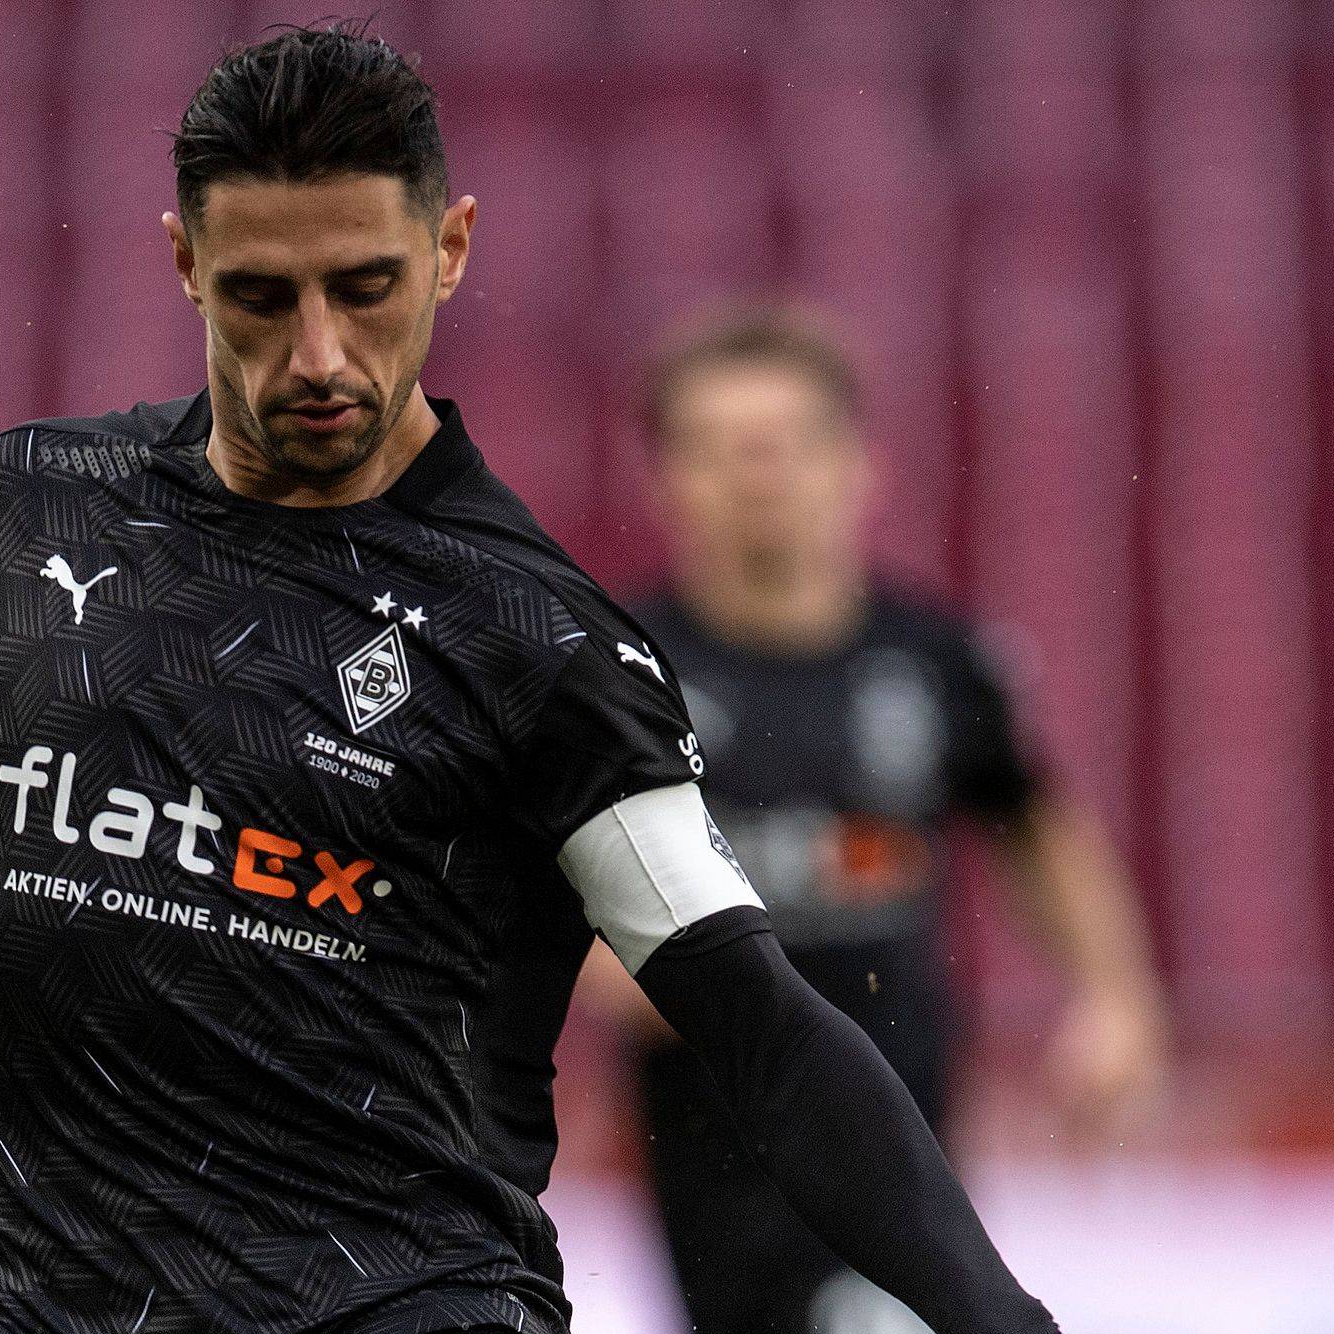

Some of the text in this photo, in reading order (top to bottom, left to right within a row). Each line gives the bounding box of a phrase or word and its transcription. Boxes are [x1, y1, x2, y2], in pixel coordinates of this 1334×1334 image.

[303, 732, 395, 776] 120 JAHRE
[309, 754, 380, 790] 1900 2020
[4, 868, 367, 963] AKTIEN. ONLINE. HANDELN.
